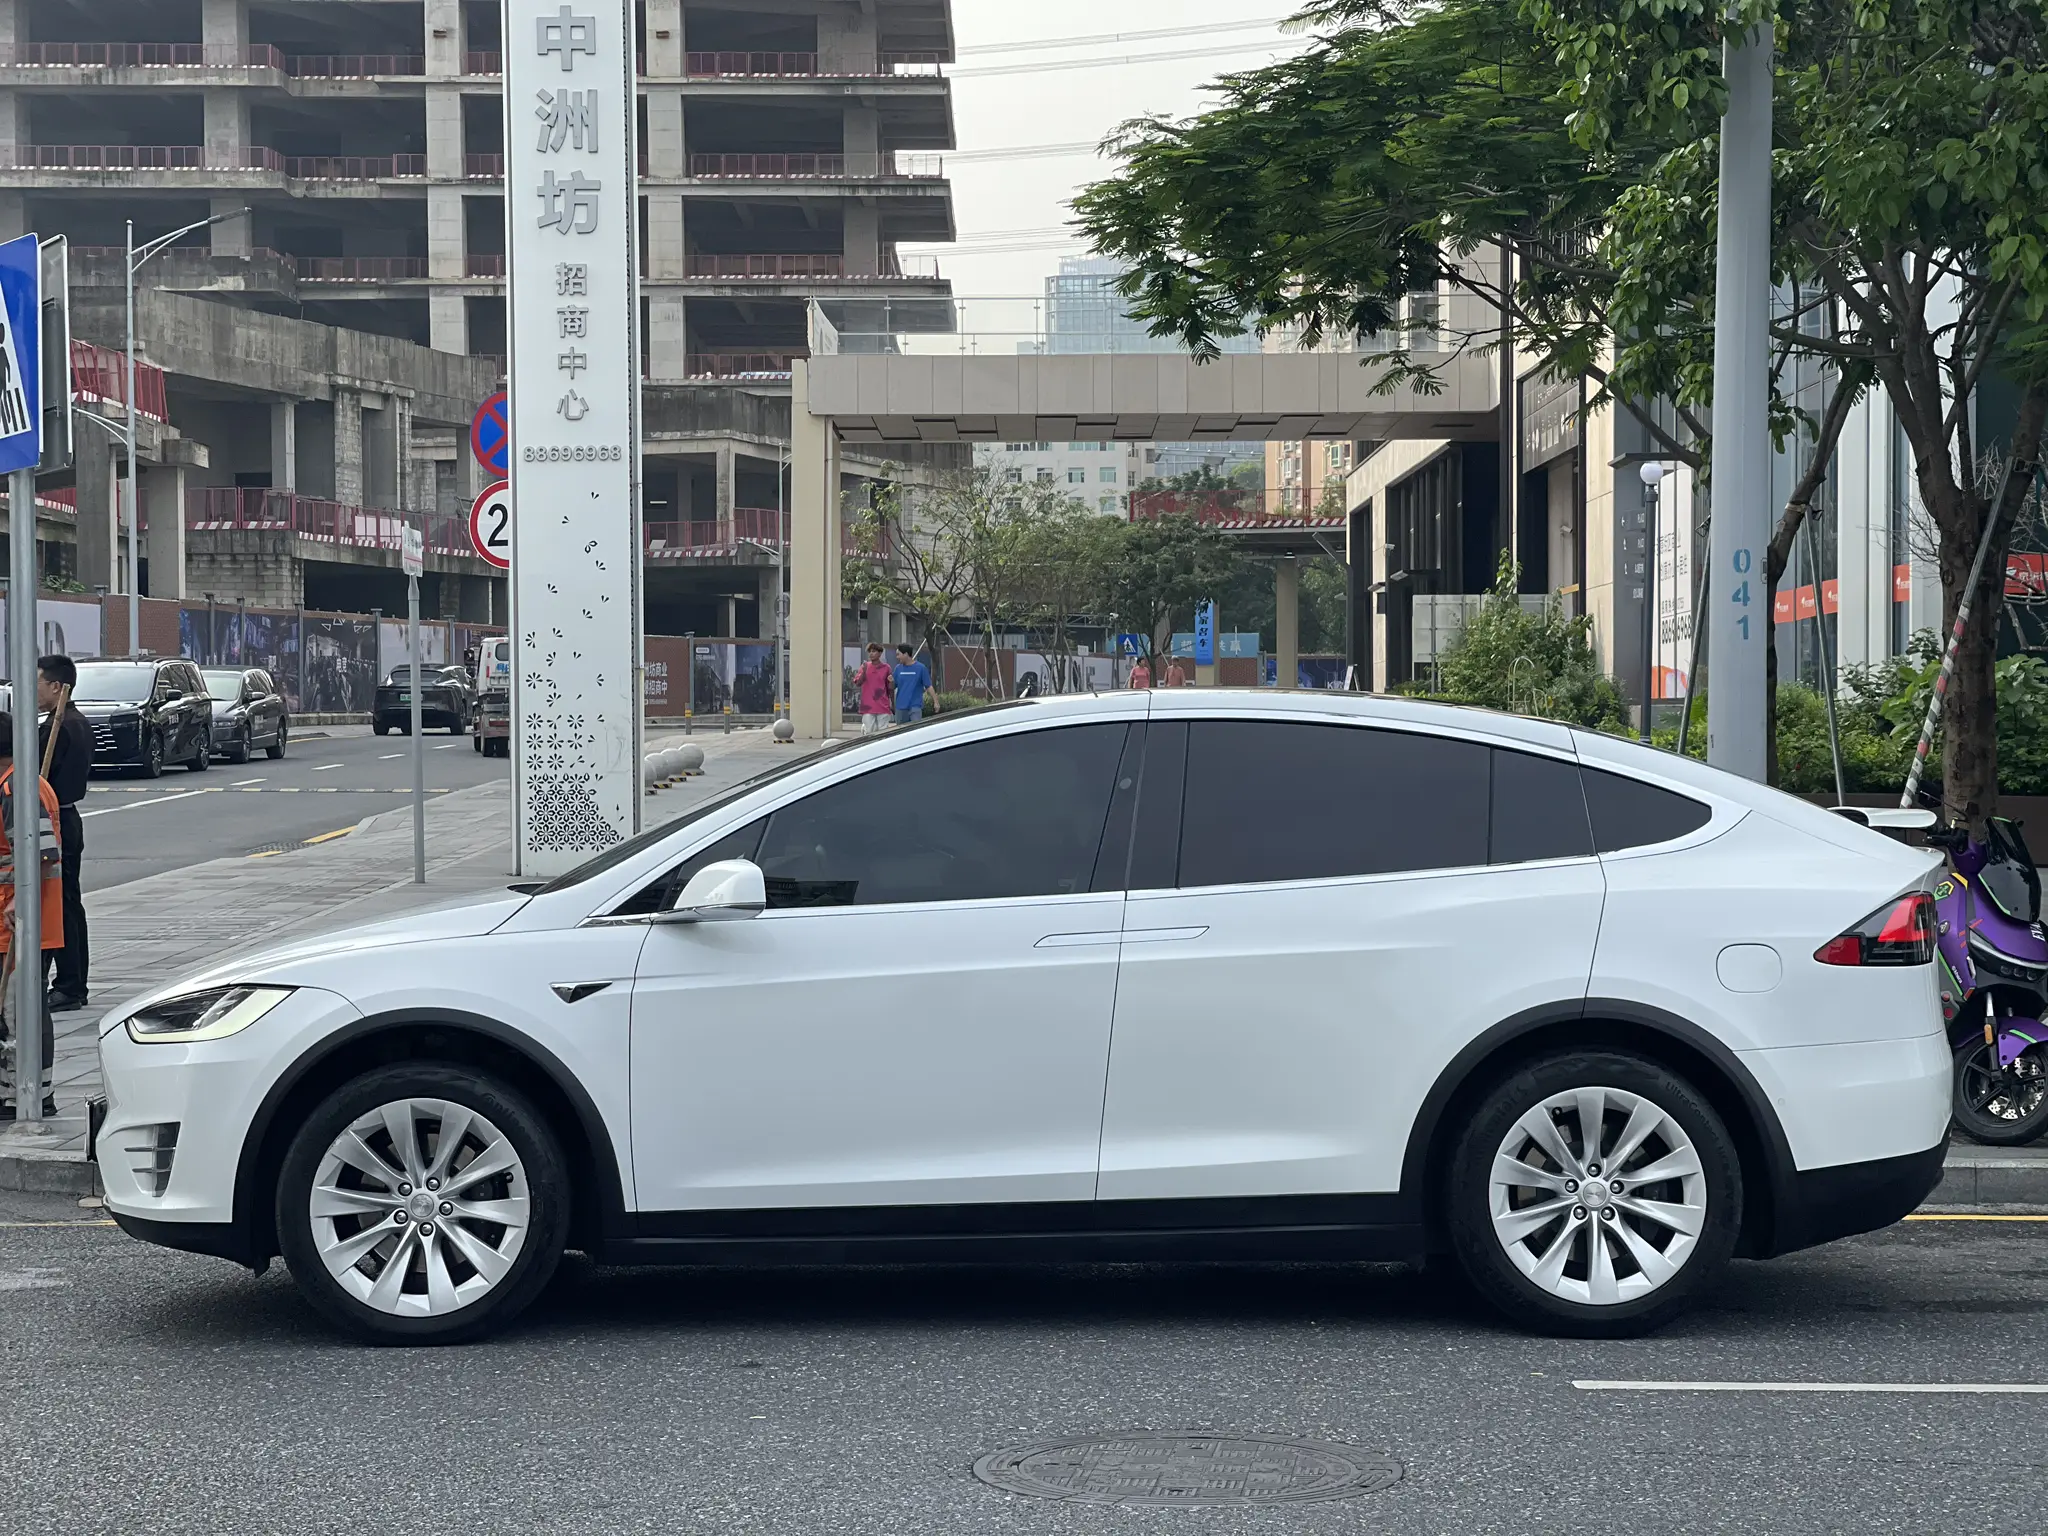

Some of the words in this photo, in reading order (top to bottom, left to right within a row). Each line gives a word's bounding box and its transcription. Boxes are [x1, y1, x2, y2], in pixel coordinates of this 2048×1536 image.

[535, 5, 601, 236] 中洲坊
[555, 262, 590, 421] 招商中心
[523, 445, 621, 462] 88696968
[1732, 548, 1751, 640] 041
